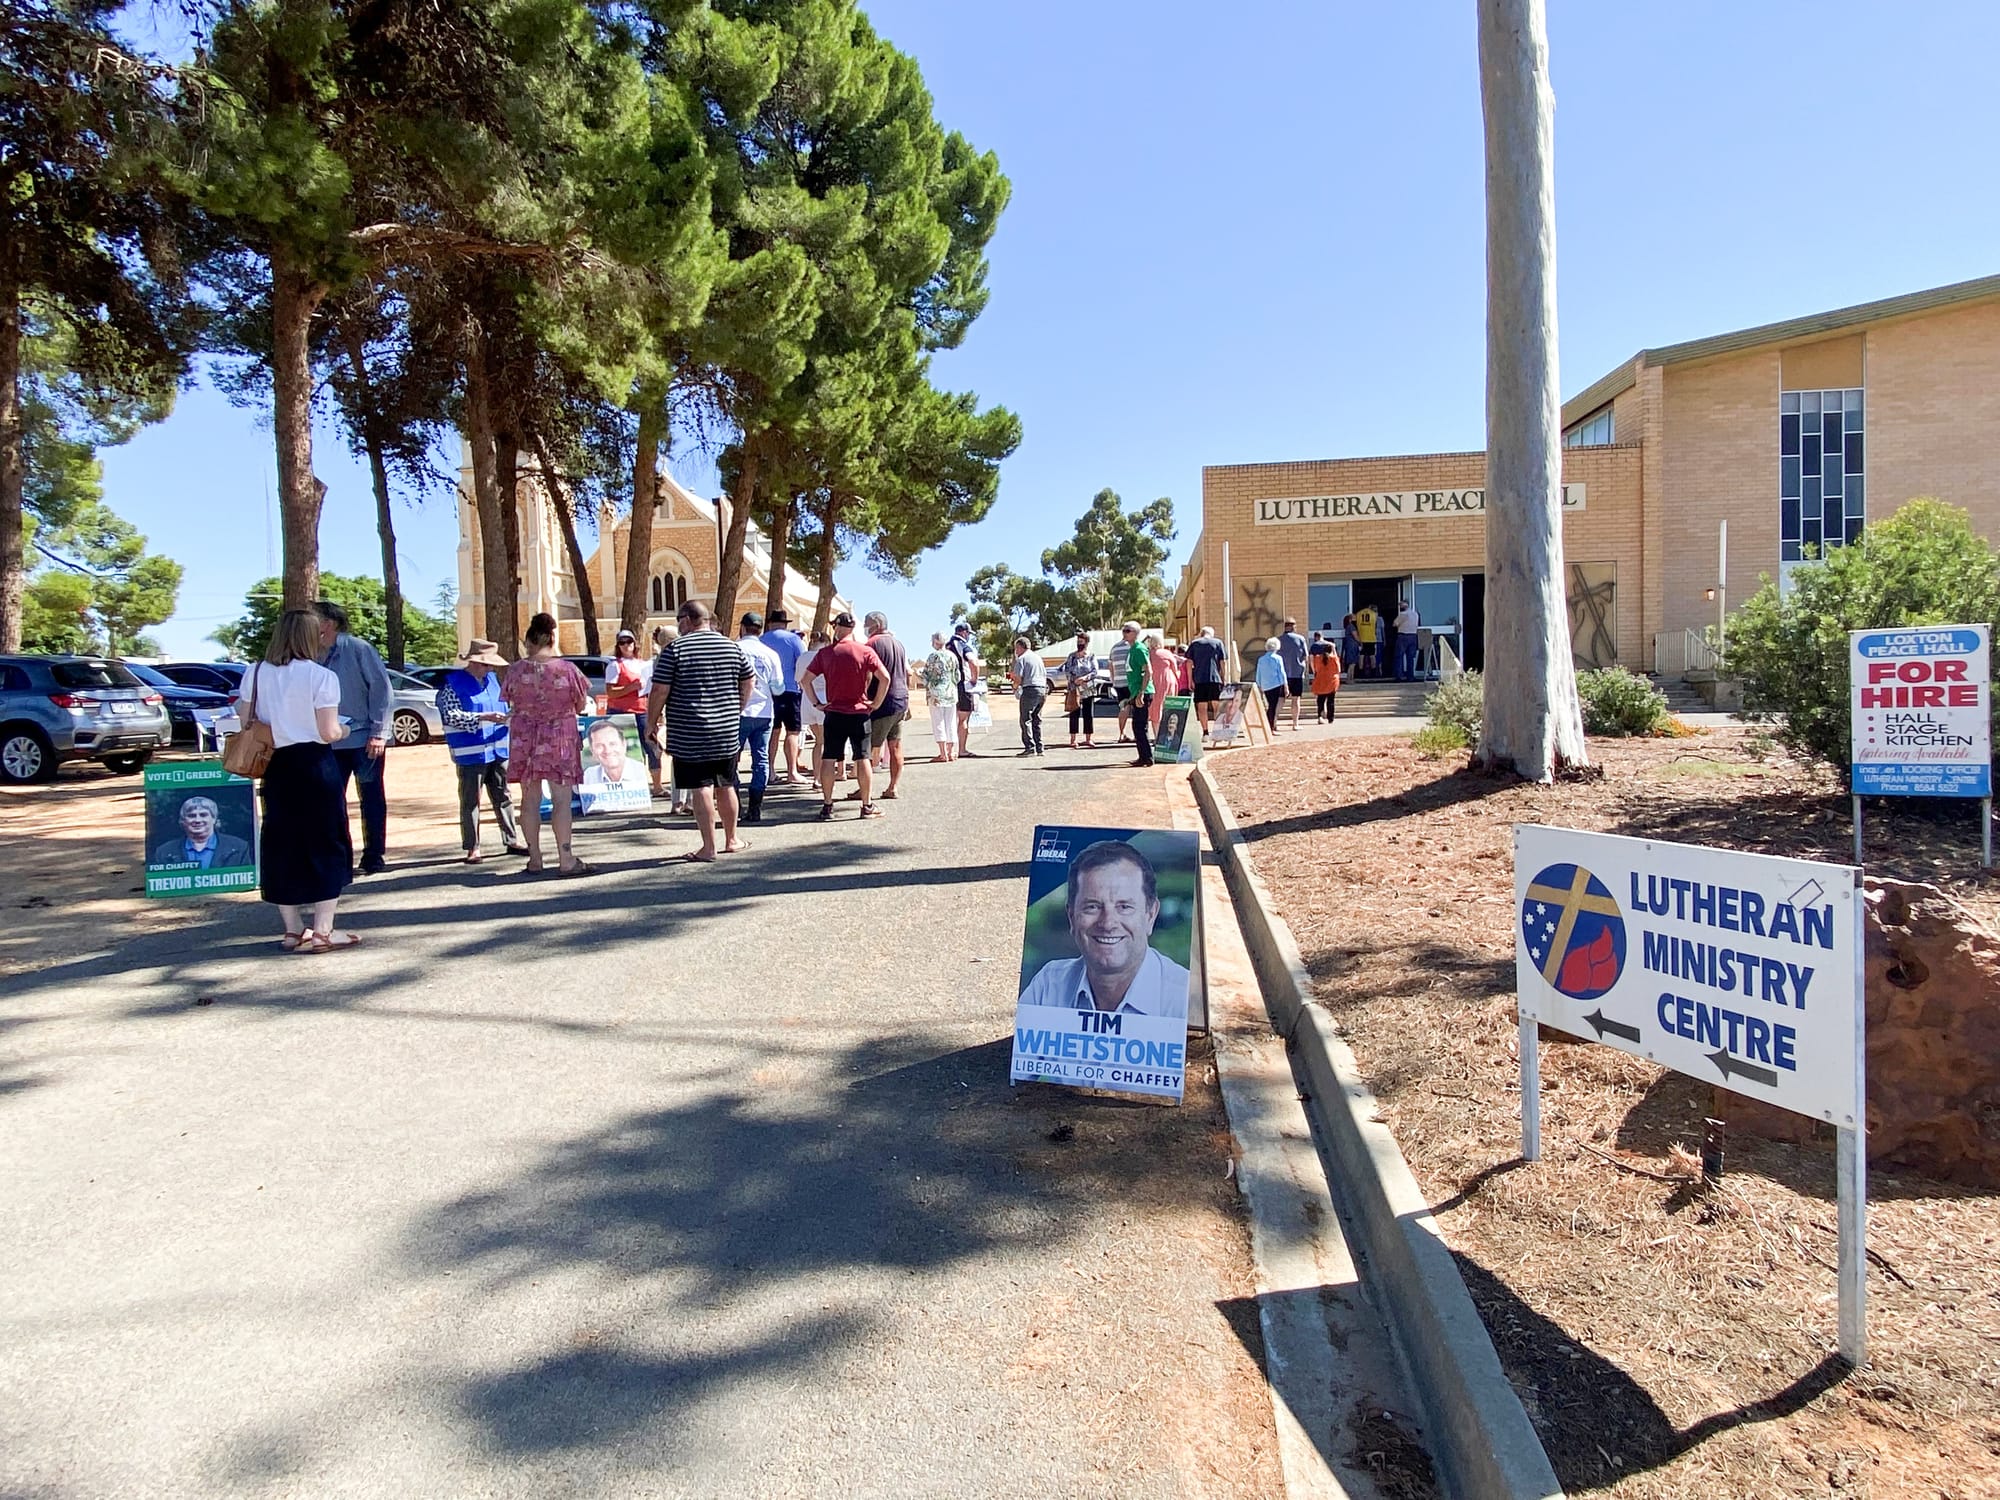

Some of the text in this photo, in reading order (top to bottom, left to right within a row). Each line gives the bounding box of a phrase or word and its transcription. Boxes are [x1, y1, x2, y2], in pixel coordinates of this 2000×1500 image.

[1259, 494, 1403, 520] LUTHERAN
[1868, 642, 1970, 657] PEACE HALL
[1885, 633, 1953, 646] LOXTON
[1868, 660, 1969, 684] FOR
[1861, 685, 1978, 708] HIRE
[1886, 713, 1937, 723] HALL
[1884, 724, 1949, 735] STAGE
[1886, 735, 1973, 746] KITCHEN
[147, 772, 172, 781] VOTE
[185, 770, 222, 780] GREENS
[605, 782, 623, 791] TIM
[1036, 849, 1068, 859] LIBERAL
[166, 862, 200, 870] CHAFFEY
[148, 871, 254, 892] TREVOR SCHLOITHE
[1630, 871, 1834, 950] LUTHERAN
[1643, 930, 1815, 1010] MINISTRY
[1078, 1011, 1122, 1035] TIM
[1657, 992, 1797, 1072] CENTRE
[1016, 1028, 1183, 1069] WHETSTONE
[1015, 1059, 1181, 1088] LIBERAL FOR CHAFFEY
